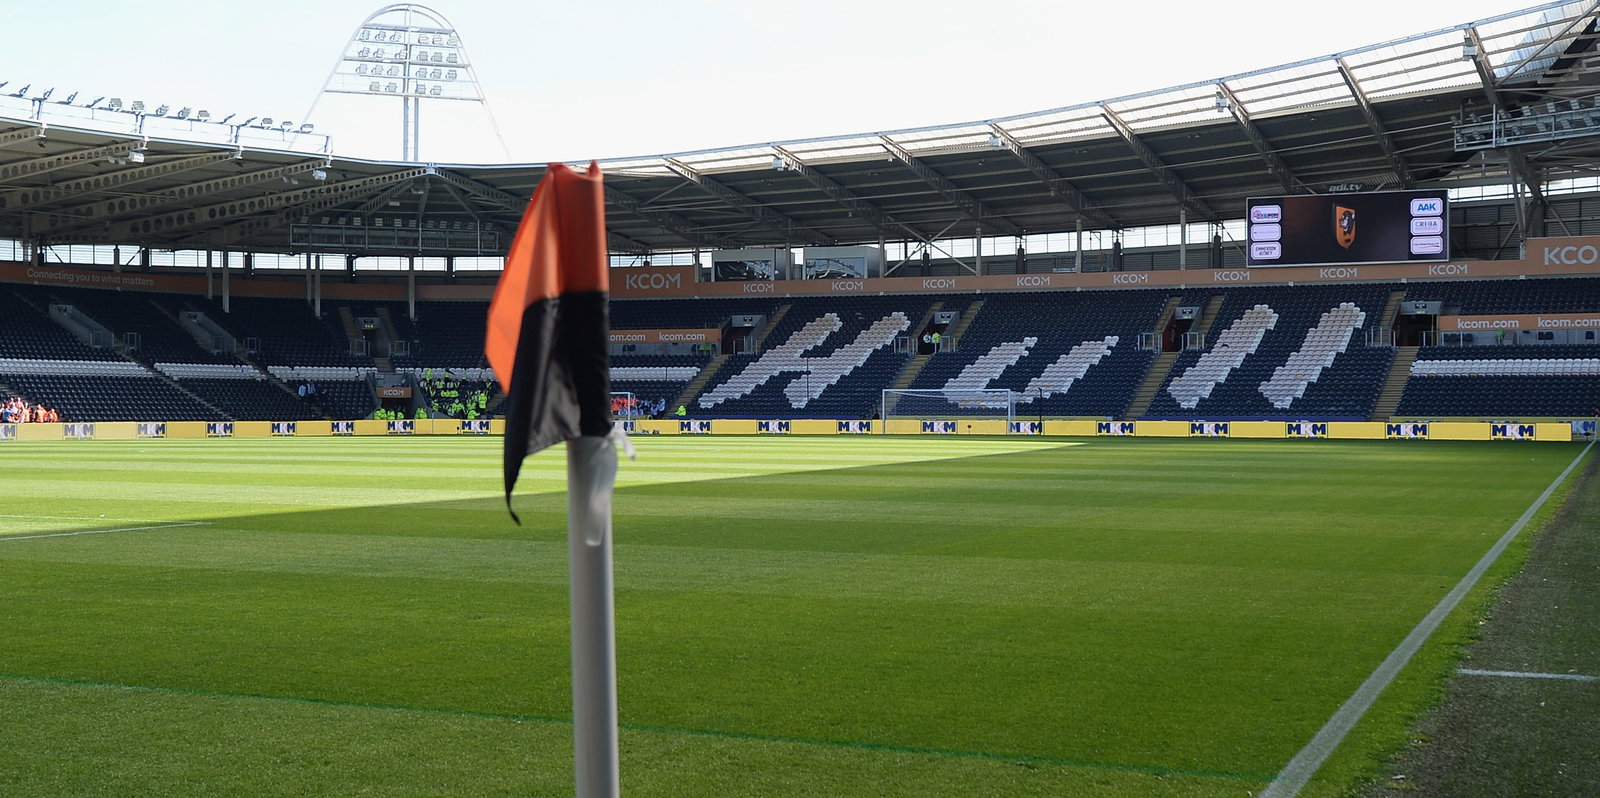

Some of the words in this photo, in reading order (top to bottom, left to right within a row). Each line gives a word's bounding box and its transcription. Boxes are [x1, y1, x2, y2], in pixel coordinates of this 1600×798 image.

[1328, 184, 1362, 192] adi.tv
[1417, 203, 1437, 211] AAK
[1544, 245, 1600, 265] KCO
[1320, 268, 1357, 279] KCOM
[1428, 264, 1468, 275] KCOM
[27, 268, 74, 282] Connecting
[76, 273, 90, 283] you
[92, 274, 100, 282] to
[101, 275, 121, 284] what
[122, 277, 154, 286] matters
[625, 273, 681, 290] KCOM
[1016, 276, 1050, 286] KCOM
[1113, 274, 1148, 284] KCOM
[1214, 271, 1250, 281] KCOM
[743, 283, 774, 293] KCOM
[832, 281, 864, 291] KCOM
[923, 279, 956, 289] KCOM
[1457, 318, 1519, 329] kcom.com
[609, 333, 646, 342] om.com
[659, 332, 706, 341] kcom.com
[0, 425, 16, 438] KM
[64, 424, 94, 438] MKM
[138, 423, 165, 437] MKM
[207, 422, 233, 435] MKM
[271, 422, 296, 434] MKM
[331, 422, 354, 434] MKM
[387, 421, 414, 432] MKM
[461, 421, 489, 432] MKM
[680, 421, 711, 434] MKM
[758, 421, 790, 434] MKM
[838, 421, 871, 434] MKM
[922, 421, 956, 434] MKM
[1009, 422, 1043, 435] MKM
[1097, 422, 1134, 435] MKM
[1191, 422, 1229, 436] MKM
[1287, 423, 1327, 438] MKM
[1387, 423, 1428, 438] MKM
[1492, 424, 1537, 439] MKM
